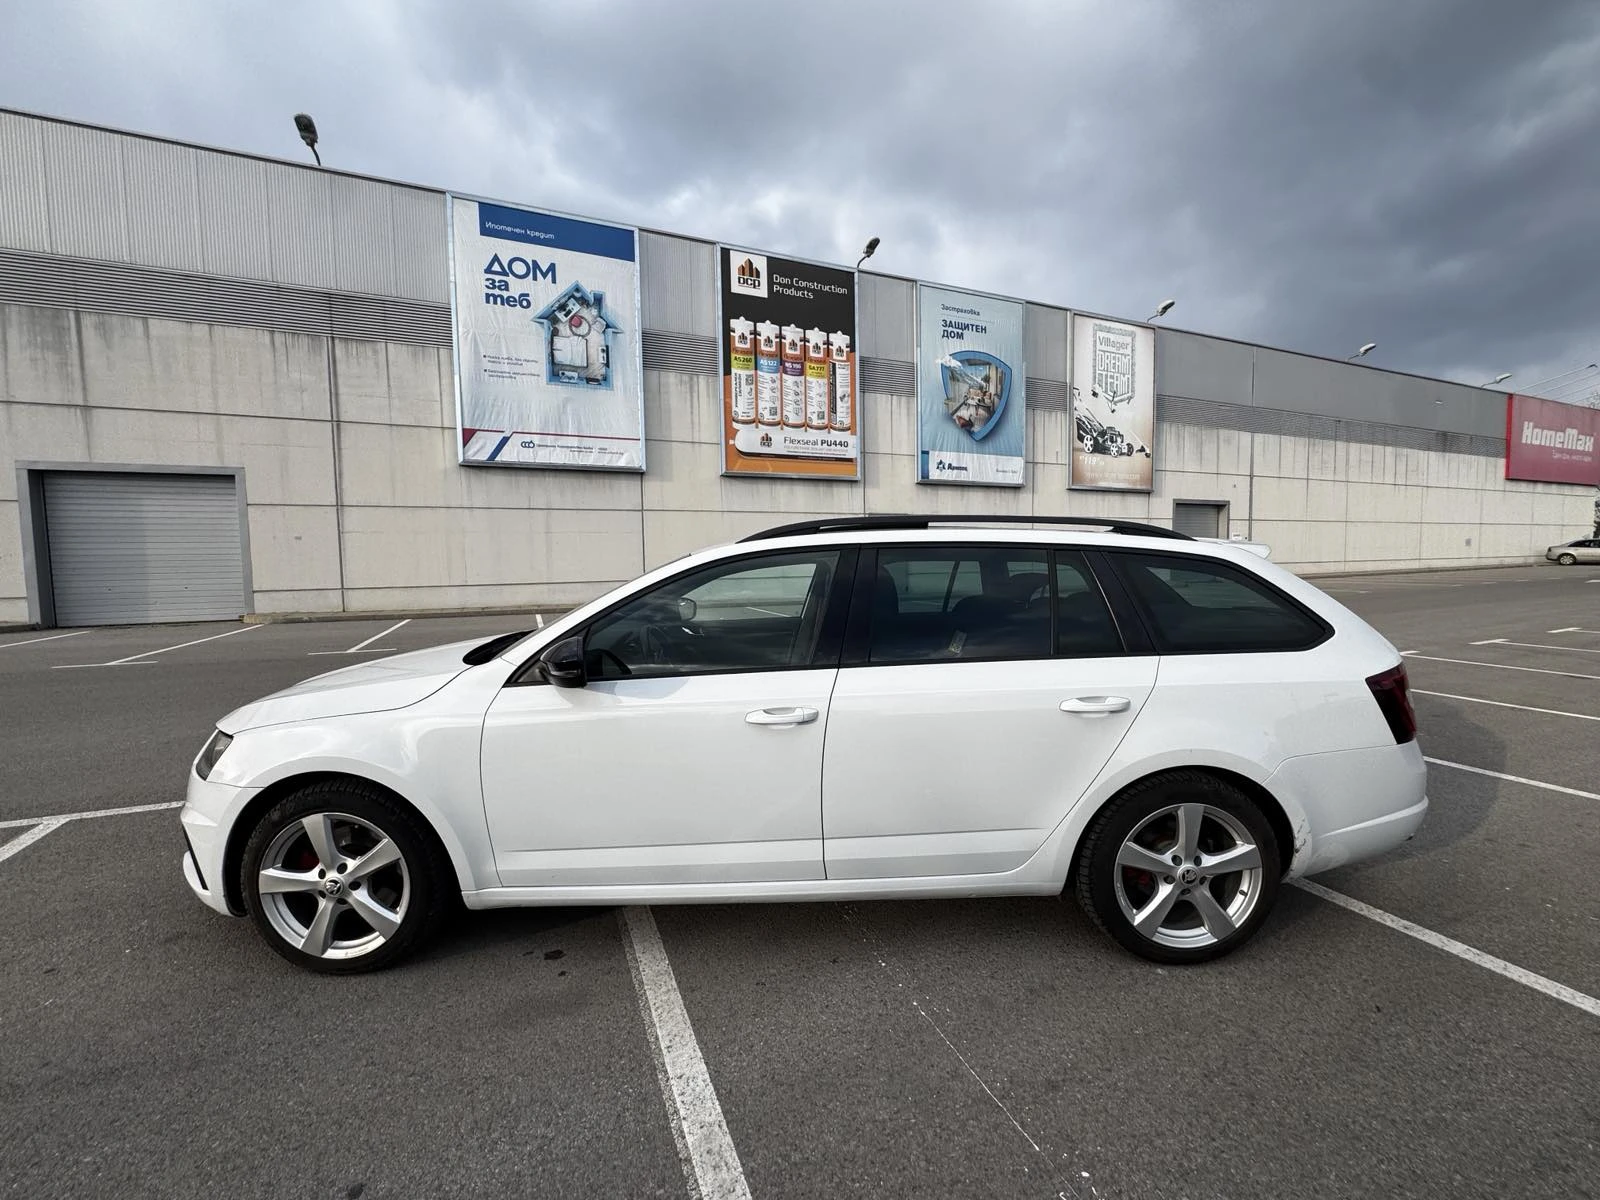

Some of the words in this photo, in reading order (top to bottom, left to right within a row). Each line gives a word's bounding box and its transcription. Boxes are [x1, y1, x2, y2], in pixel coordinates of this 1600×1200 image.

[485, 221, 525, 235] Ипотечен
[526, 228, 555, 240] кредит
[483, 252, 557, 285] ДОМ
[484, 277, 510, 292] за
[773, 274, 791, 285] Don
[793, 277, 848, 295] Construction
[773, 284, 814, 299] Products
[484, 292, 532, 309] теб
[940, 303, 980, 316] Застраховка
[941, 319, 987, 334] ЗАЩИТЕН
[941, 329, 964, 340] ДОМ
[1098, 335, 1130, 351] Villager
[1097, 351, 1131, 375] DREAM
[1097, 371, 1131, 398] TEAM
[783, 436, 819, 446] Flexseal
[820, 439, 849, 448] PU440
[1521, 421, 1594, 452] HomeMax
